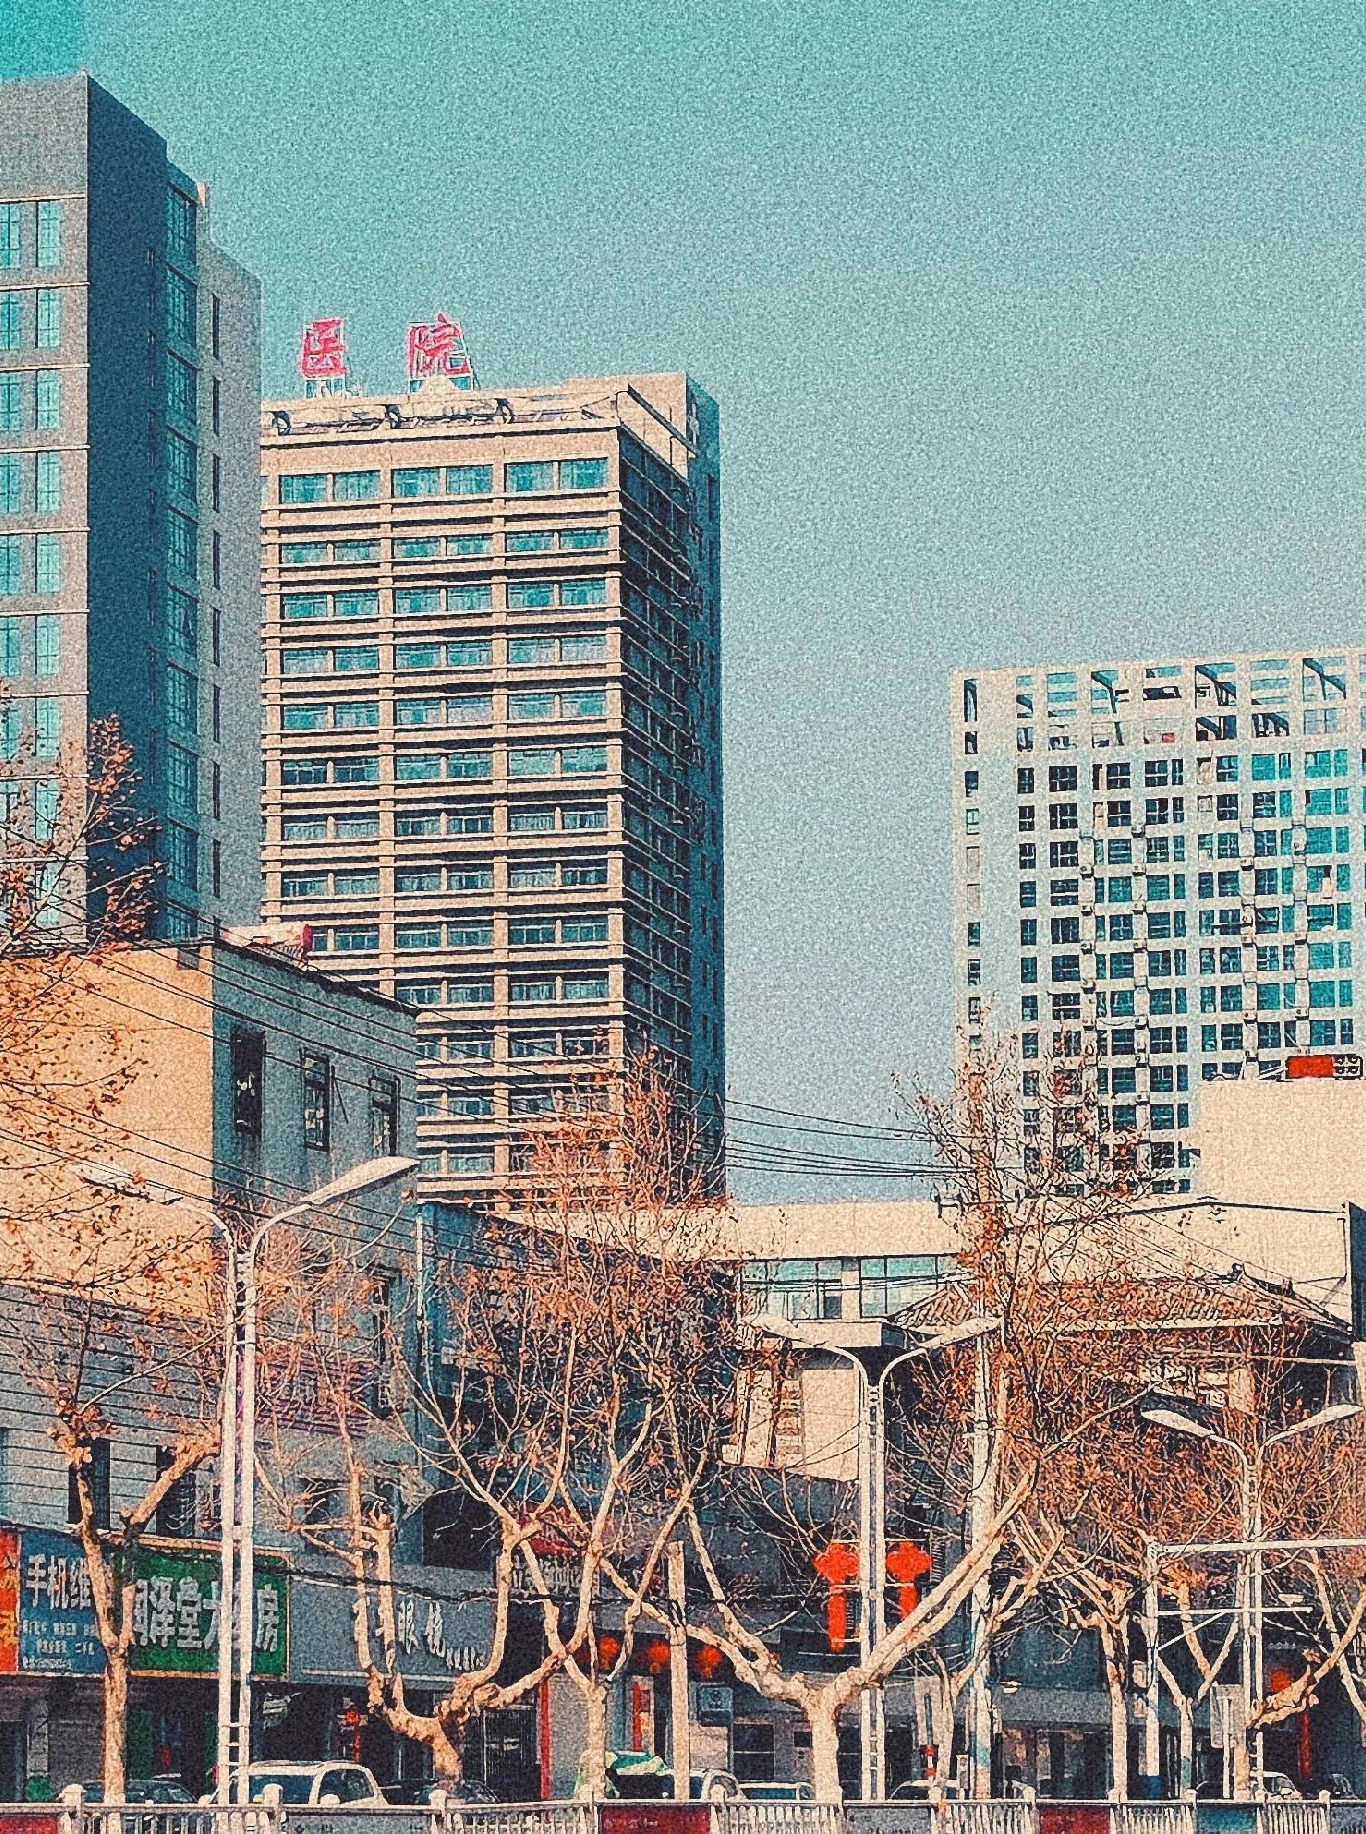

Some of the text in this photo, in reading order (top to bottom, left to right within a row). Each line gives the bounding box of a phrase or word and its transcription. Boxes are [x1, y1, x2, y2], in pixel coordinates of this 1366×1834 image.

[300, 312, 472, 378] 医院
[26, 1553, 115, 1610] 手机维
[128, 1575, 280, 1652] 润泽堂大房
